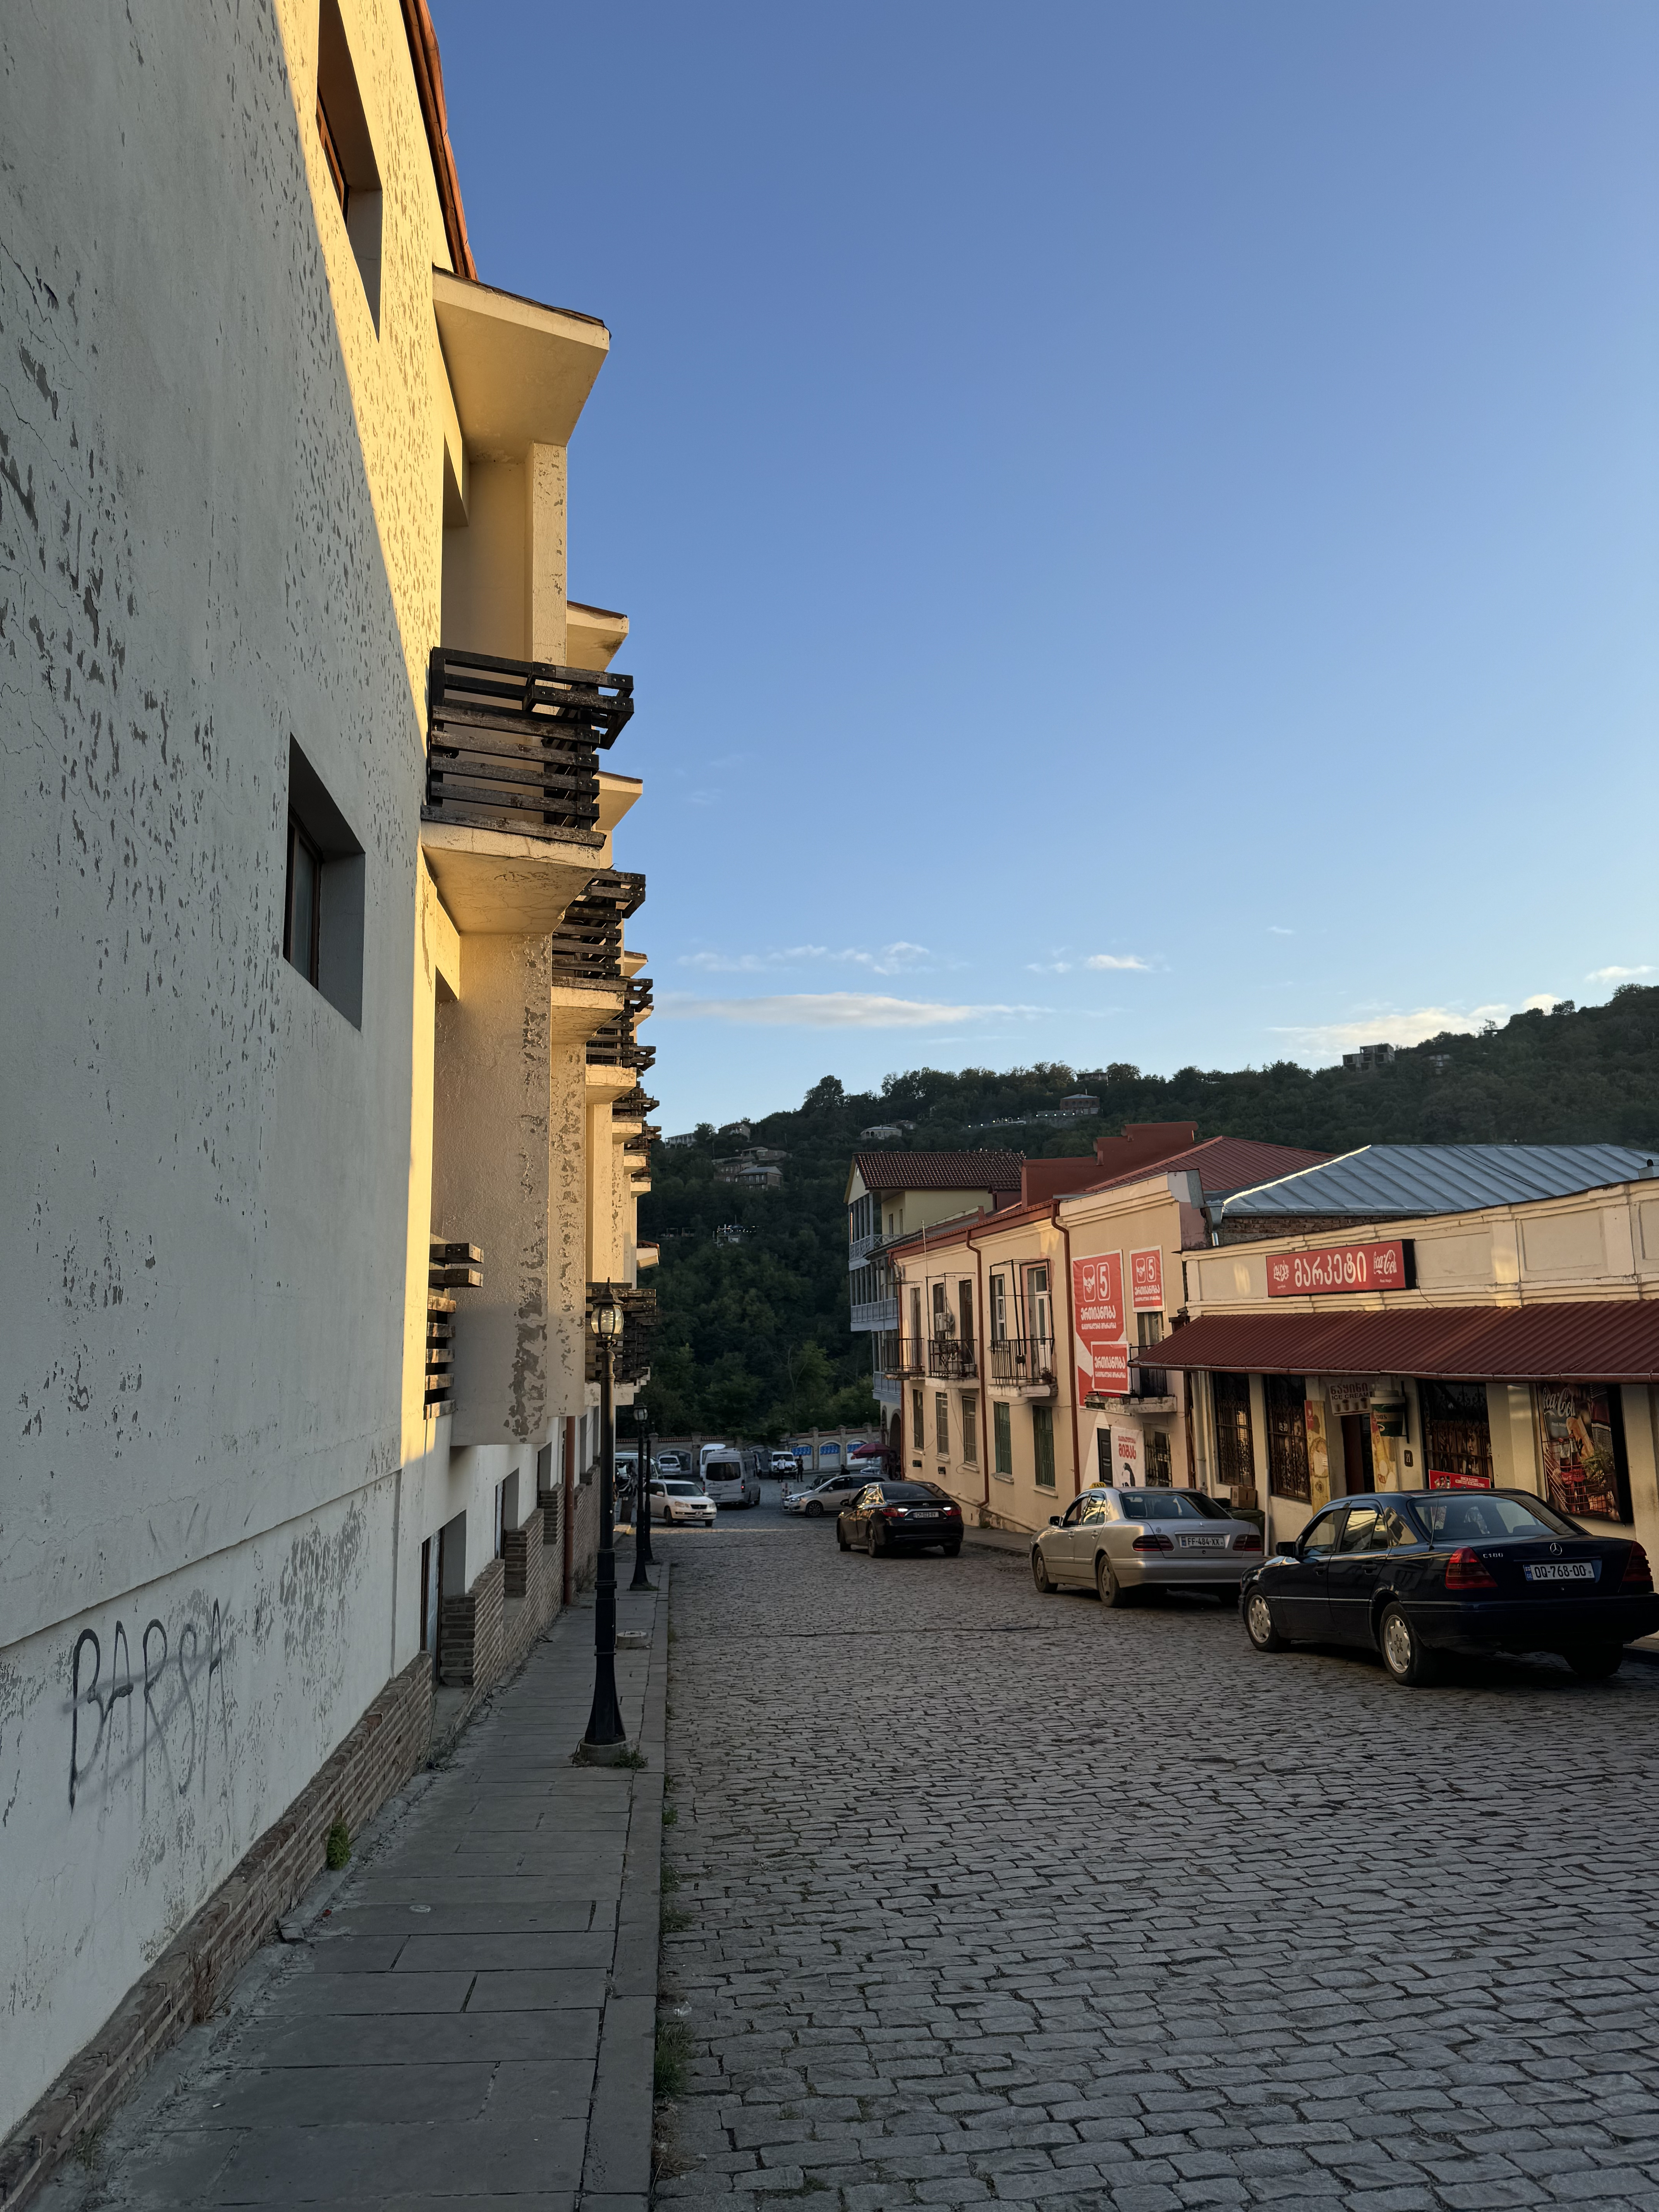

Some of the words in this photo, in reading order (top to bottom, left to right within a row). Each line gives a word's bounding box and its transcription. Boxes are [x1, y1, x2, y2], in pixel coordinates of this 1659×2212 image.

[1100, 1266, 1108, 1297] 5
[1148, 1259, 1154, 1279] 5
[1294, 1251, 1367, 1287] მარკეტი
